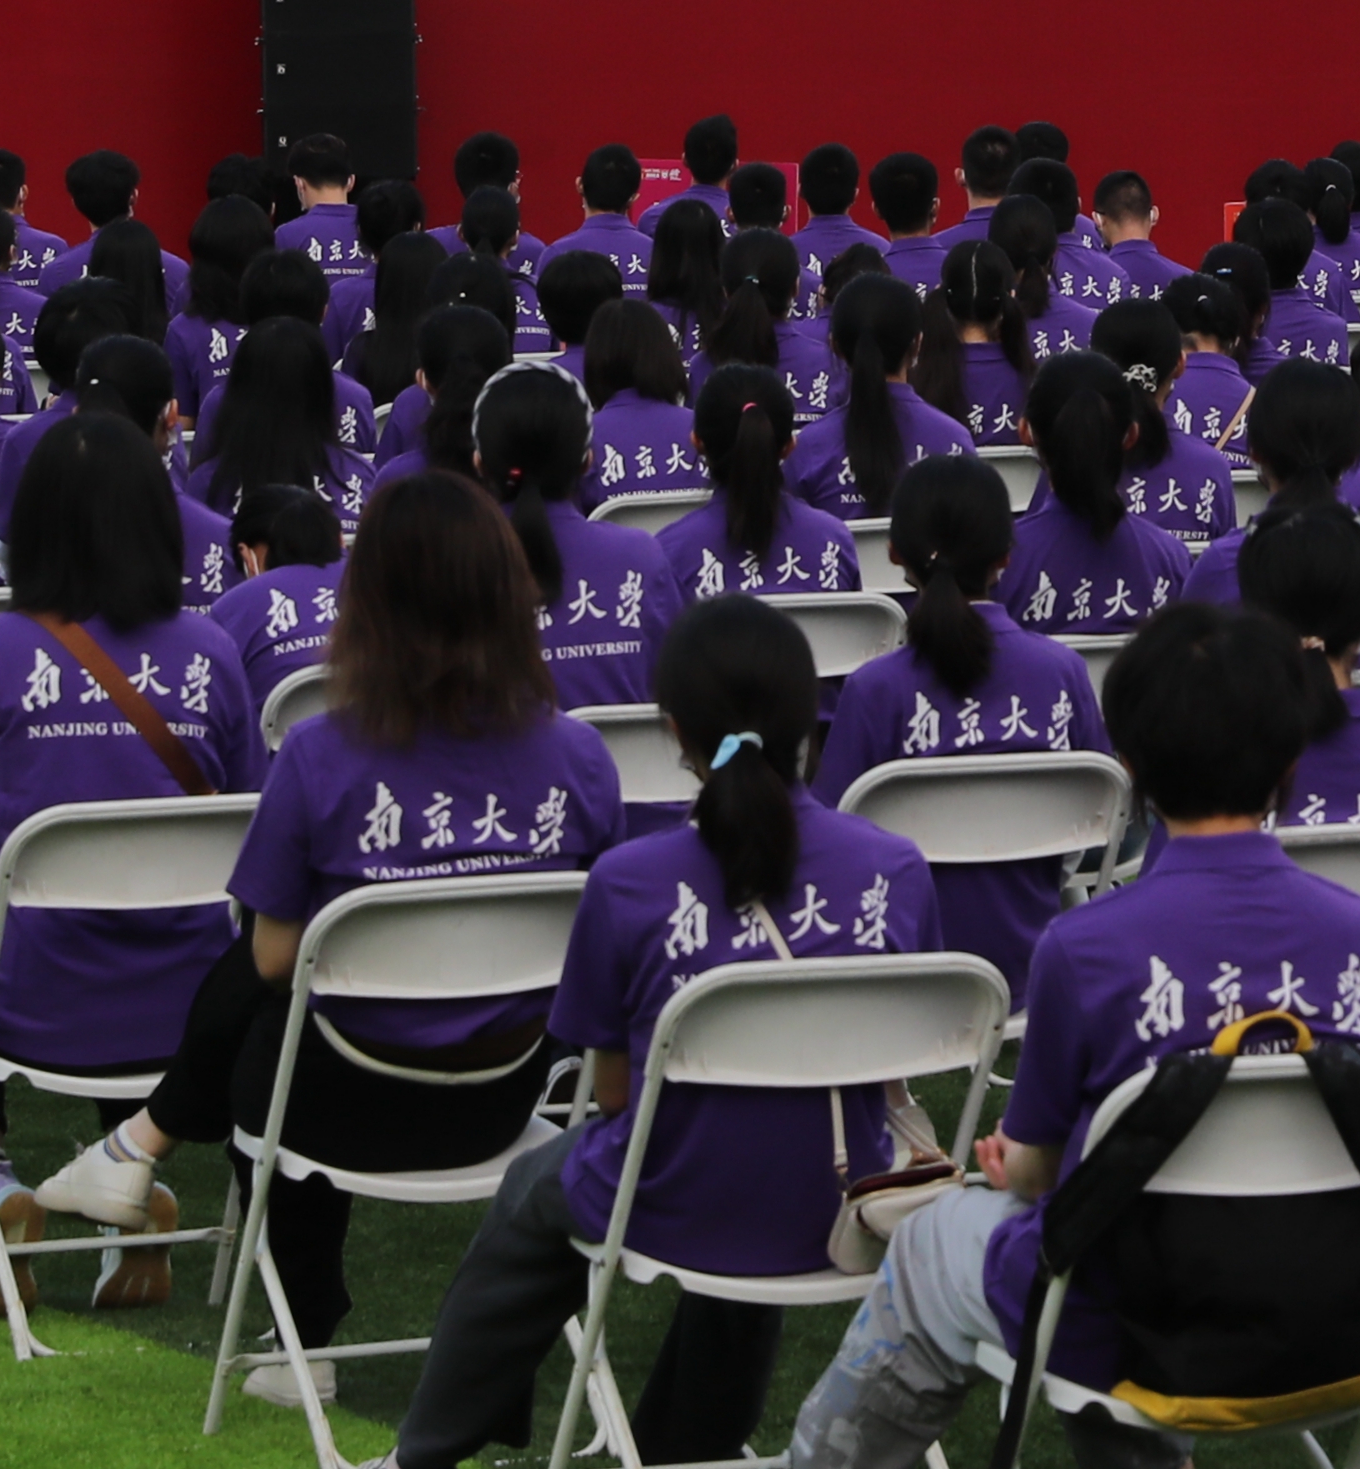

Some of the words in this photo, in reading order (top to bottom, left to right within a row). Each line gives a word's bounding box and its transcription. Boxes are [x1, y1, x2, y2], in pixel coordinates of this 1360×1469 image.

[308, 238, 364, 261] 南京大
[1060, 272, 1121, 303] 京大學
[601, 444, 708, 486] 南京大
[1127, 478, 1215, 523] 京大學
[695, 541, 844, 599] 南京大學
[556, 641, 640, 659] UNIVERSITY
[29, 723, 107, 738] NANJING
[904, 690, 1074, 754] 南京大學
[359, 782, 567, 855] 南京大學
